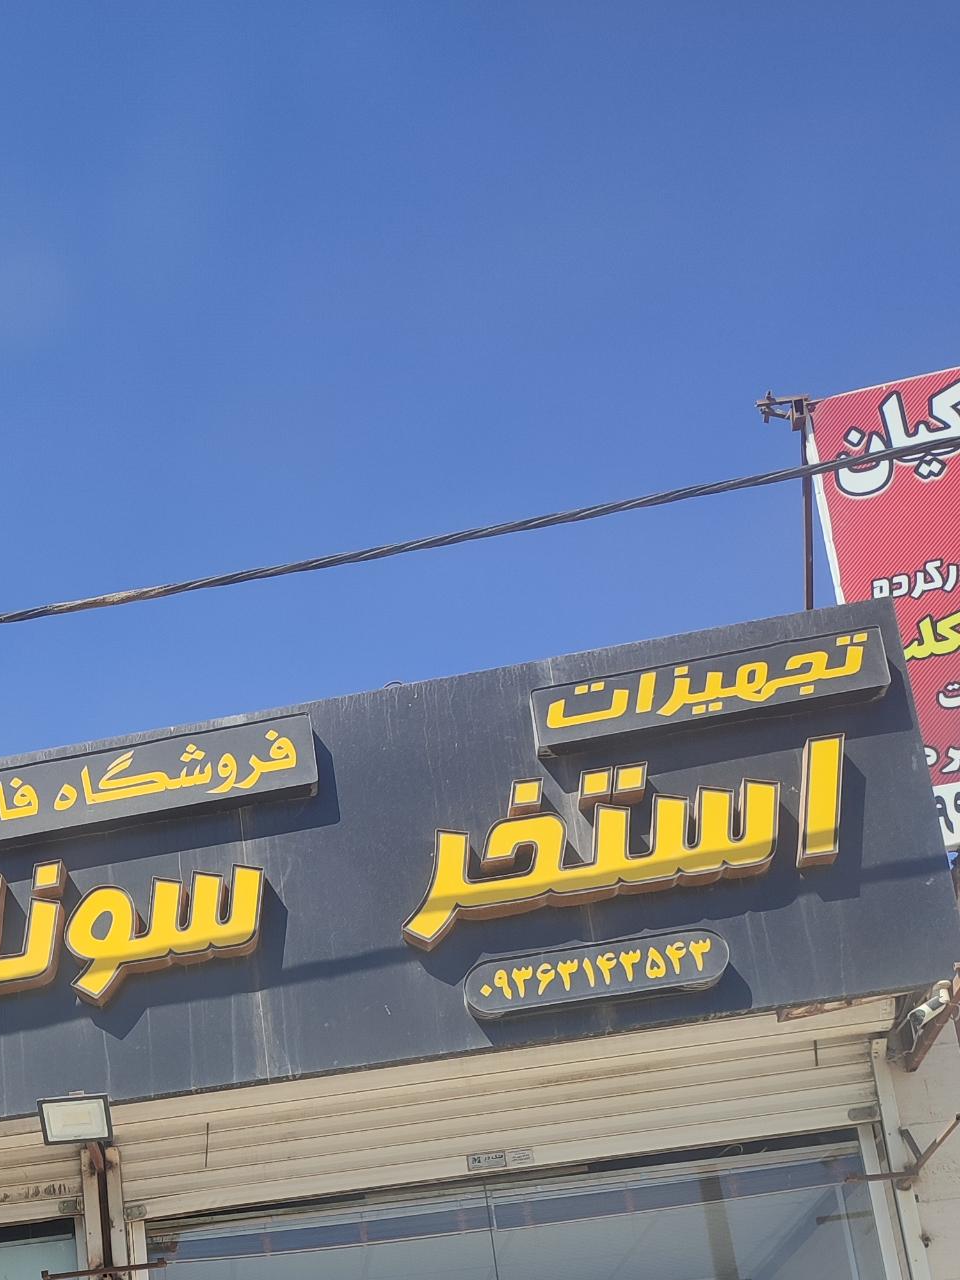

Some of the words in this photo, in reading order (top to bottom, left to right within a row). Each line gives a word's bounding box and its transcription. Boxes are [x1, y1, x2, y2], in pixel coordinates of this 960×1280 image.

[546, 632, 868, 730] تجهیزات
[53, 729, 298, 811] فروشگاه
[403, 734, 844, 942] استخر
[479, 938, 712, 1000] ۰۹۳۶۳۱۴۳۵۴۳
